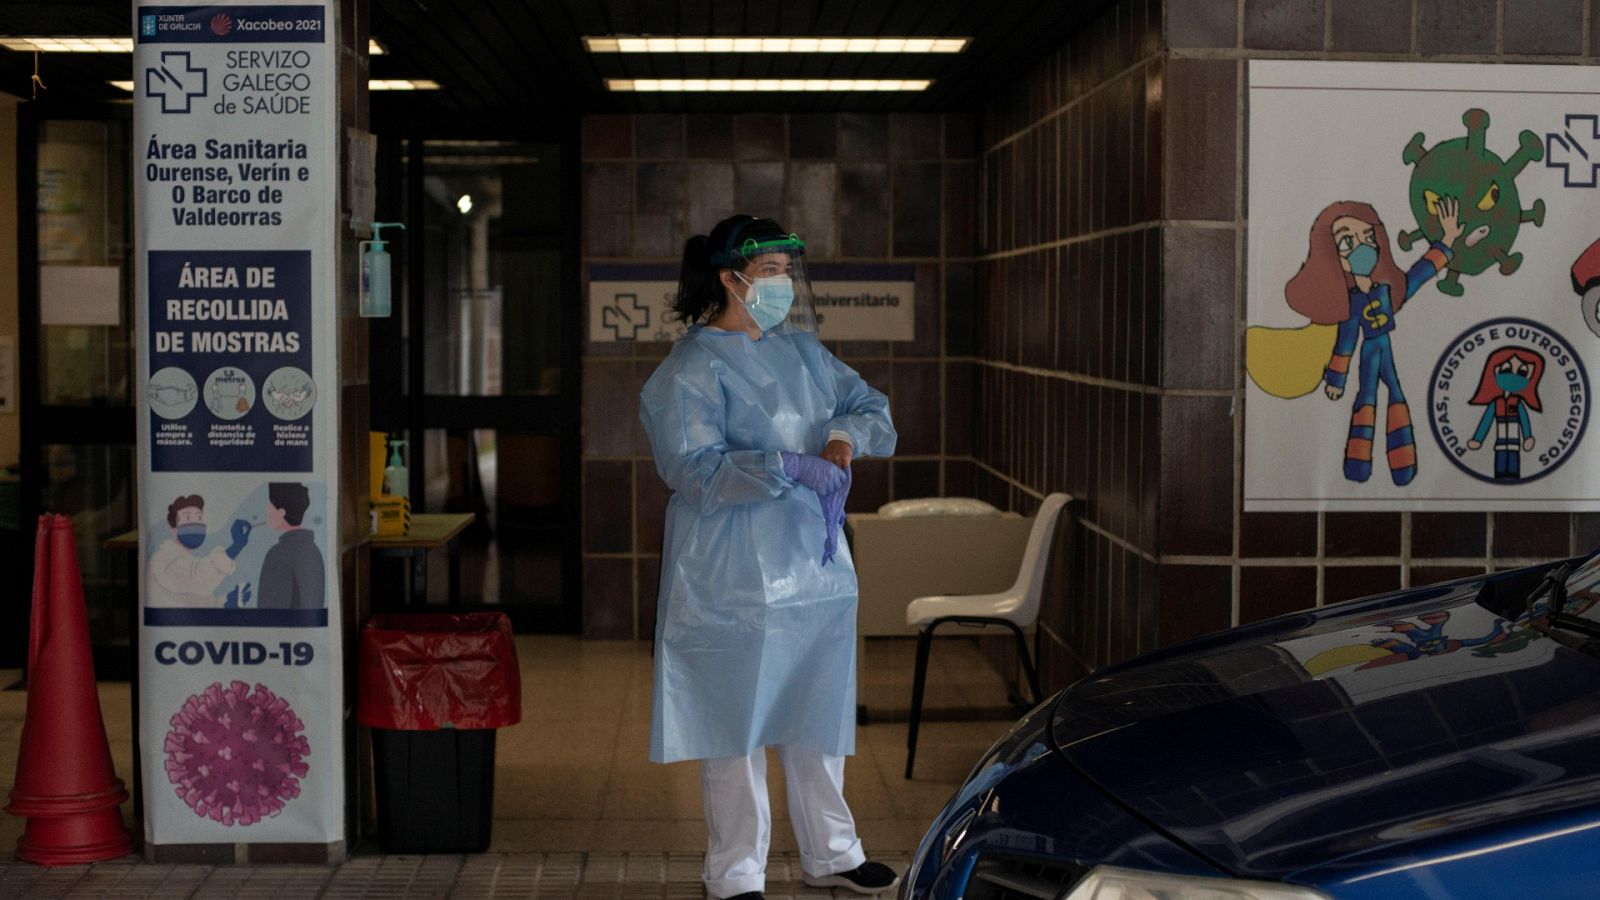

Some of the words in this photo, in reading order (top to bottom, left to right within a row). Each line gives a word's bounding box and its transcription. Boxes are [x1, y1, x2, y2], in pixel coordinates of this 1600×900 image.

[158, 14, 185, 22] XUNTA
[158, 23, 169, 31] DE
[170, 23, 201, 31] GALICIA
[237, 18, 293, 31] Xacobeo
[296, 19, 321, 31] 2021
[226, 50, 311, 69] SERVIZO
[223, 73, 311, 92] GALEGO
[213, 94, 236, 114] de
[243, 93, 310, 114] SAÚDE
[146, 134, 197, 160] Área
[205, 138, 308, 160] Sanitaria
[146, 163, 233, 185] Ourense,
[238, 162, 290, 181] Verín
[297, 166, 309, 181] e
[172, 185, 185, 204] O
[193, 185, 251, 204] Barco
[258, 185, 283, 204] de
[172, 207, 282, 226] Valdeorras
[178, 262, 240, 289] ÁREA
[246, 267, 275, 289] DE
[166, 299, 289, 321] RECOLLIDA
[156, 331, 184, 353] DE
[192, 331, 300, 354] MOSTRAS
[1489, 328, 1500, 341] E
[1505, 326, 1570, 367] OUTROS
[1438, 334, 1486, 391] SUSTOS
[1436, 396, 1467, 458] PUPAS,
[1538, 369, 1582, 466] DESGUSTOS
[154, 640, 315, 666] COVID-19
